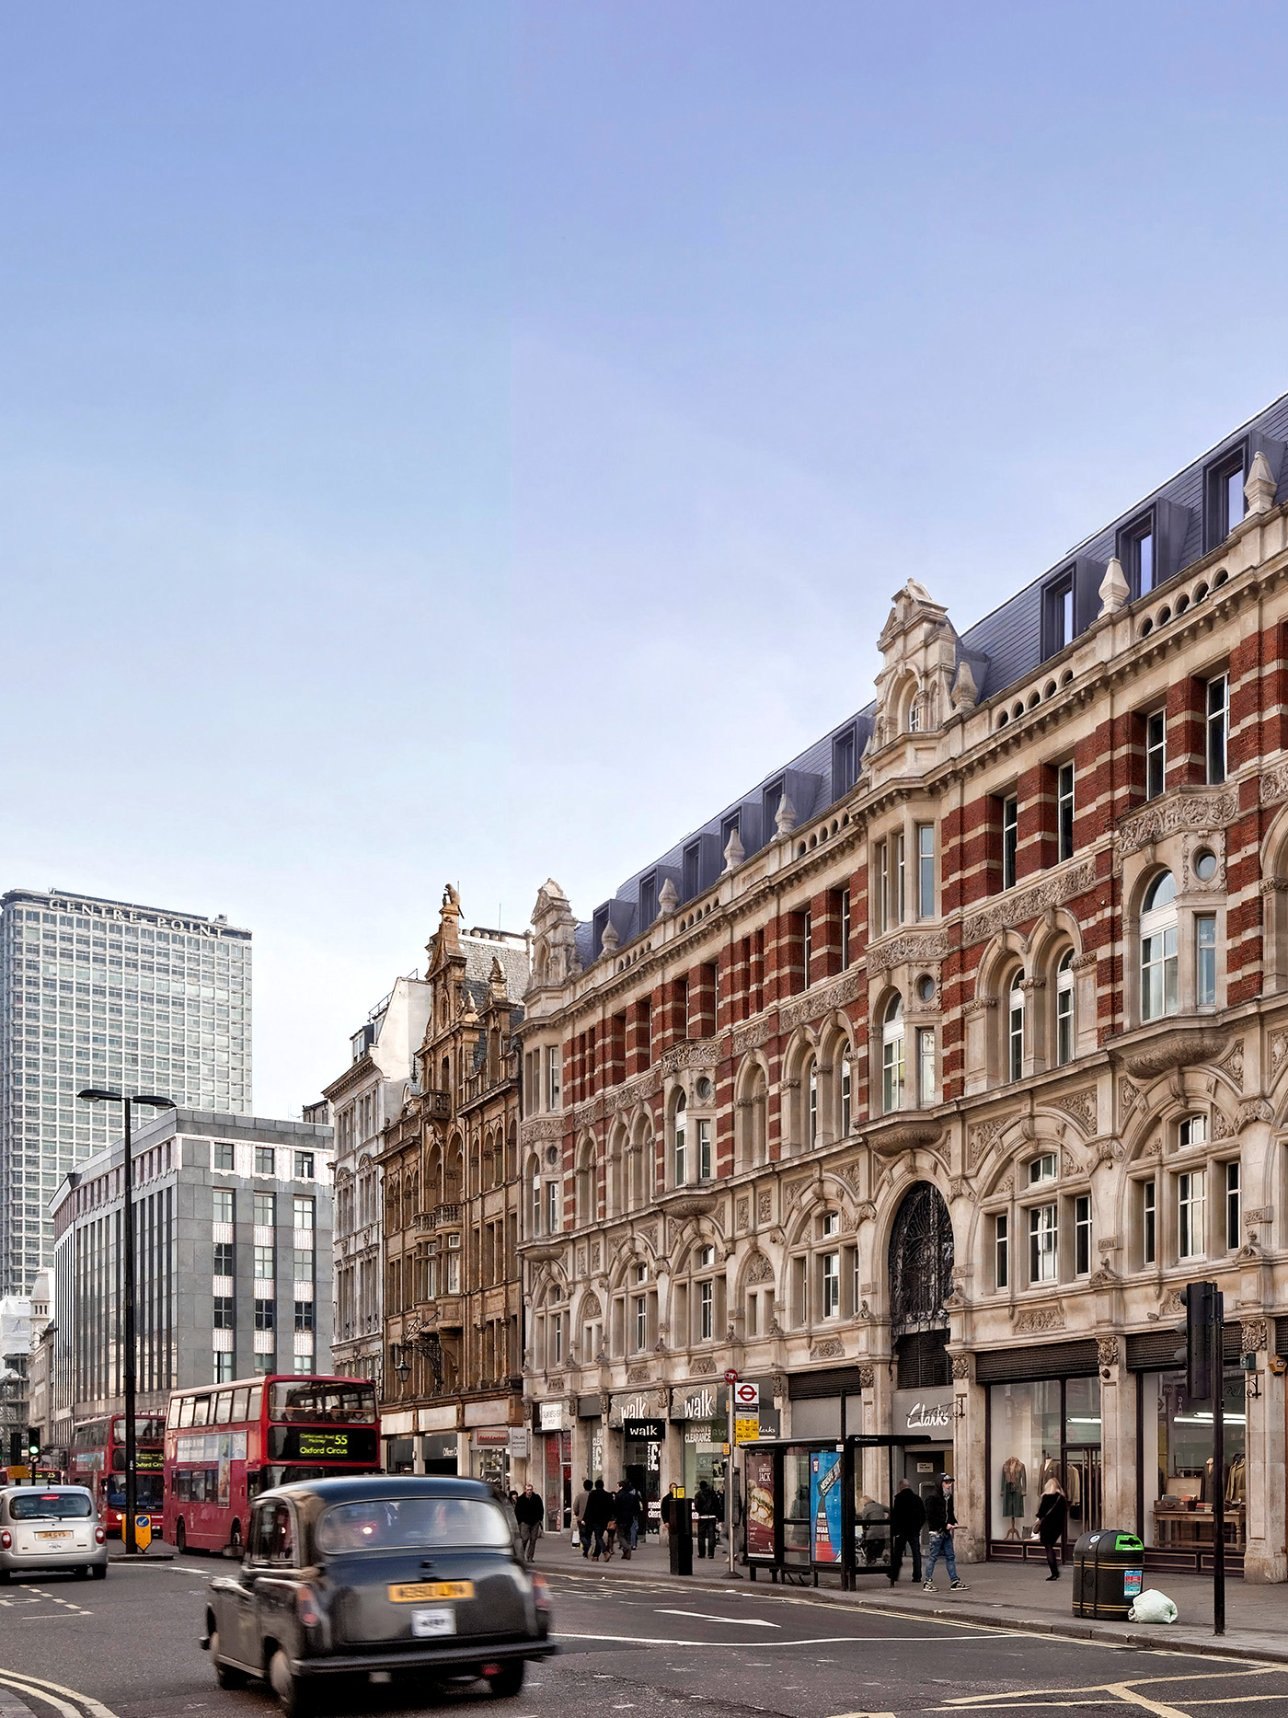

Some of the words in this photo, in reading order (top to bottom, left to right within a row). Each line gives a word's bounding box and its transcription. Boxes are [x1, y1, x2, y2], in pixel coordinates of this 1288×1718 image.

[50, 900, 138, 923] CENTRE
[157, 917, 224, 939] POINT
[621, 1397, 646, 1422] walk
[684, 1389, 713, 1418] walk
[907, 1403, 949, 1428] Clarks
[334, 1434, 348, 1445] 55
[630, 1425, 658, 1436] walk
[759, 1473, 771, 1481] JACK
